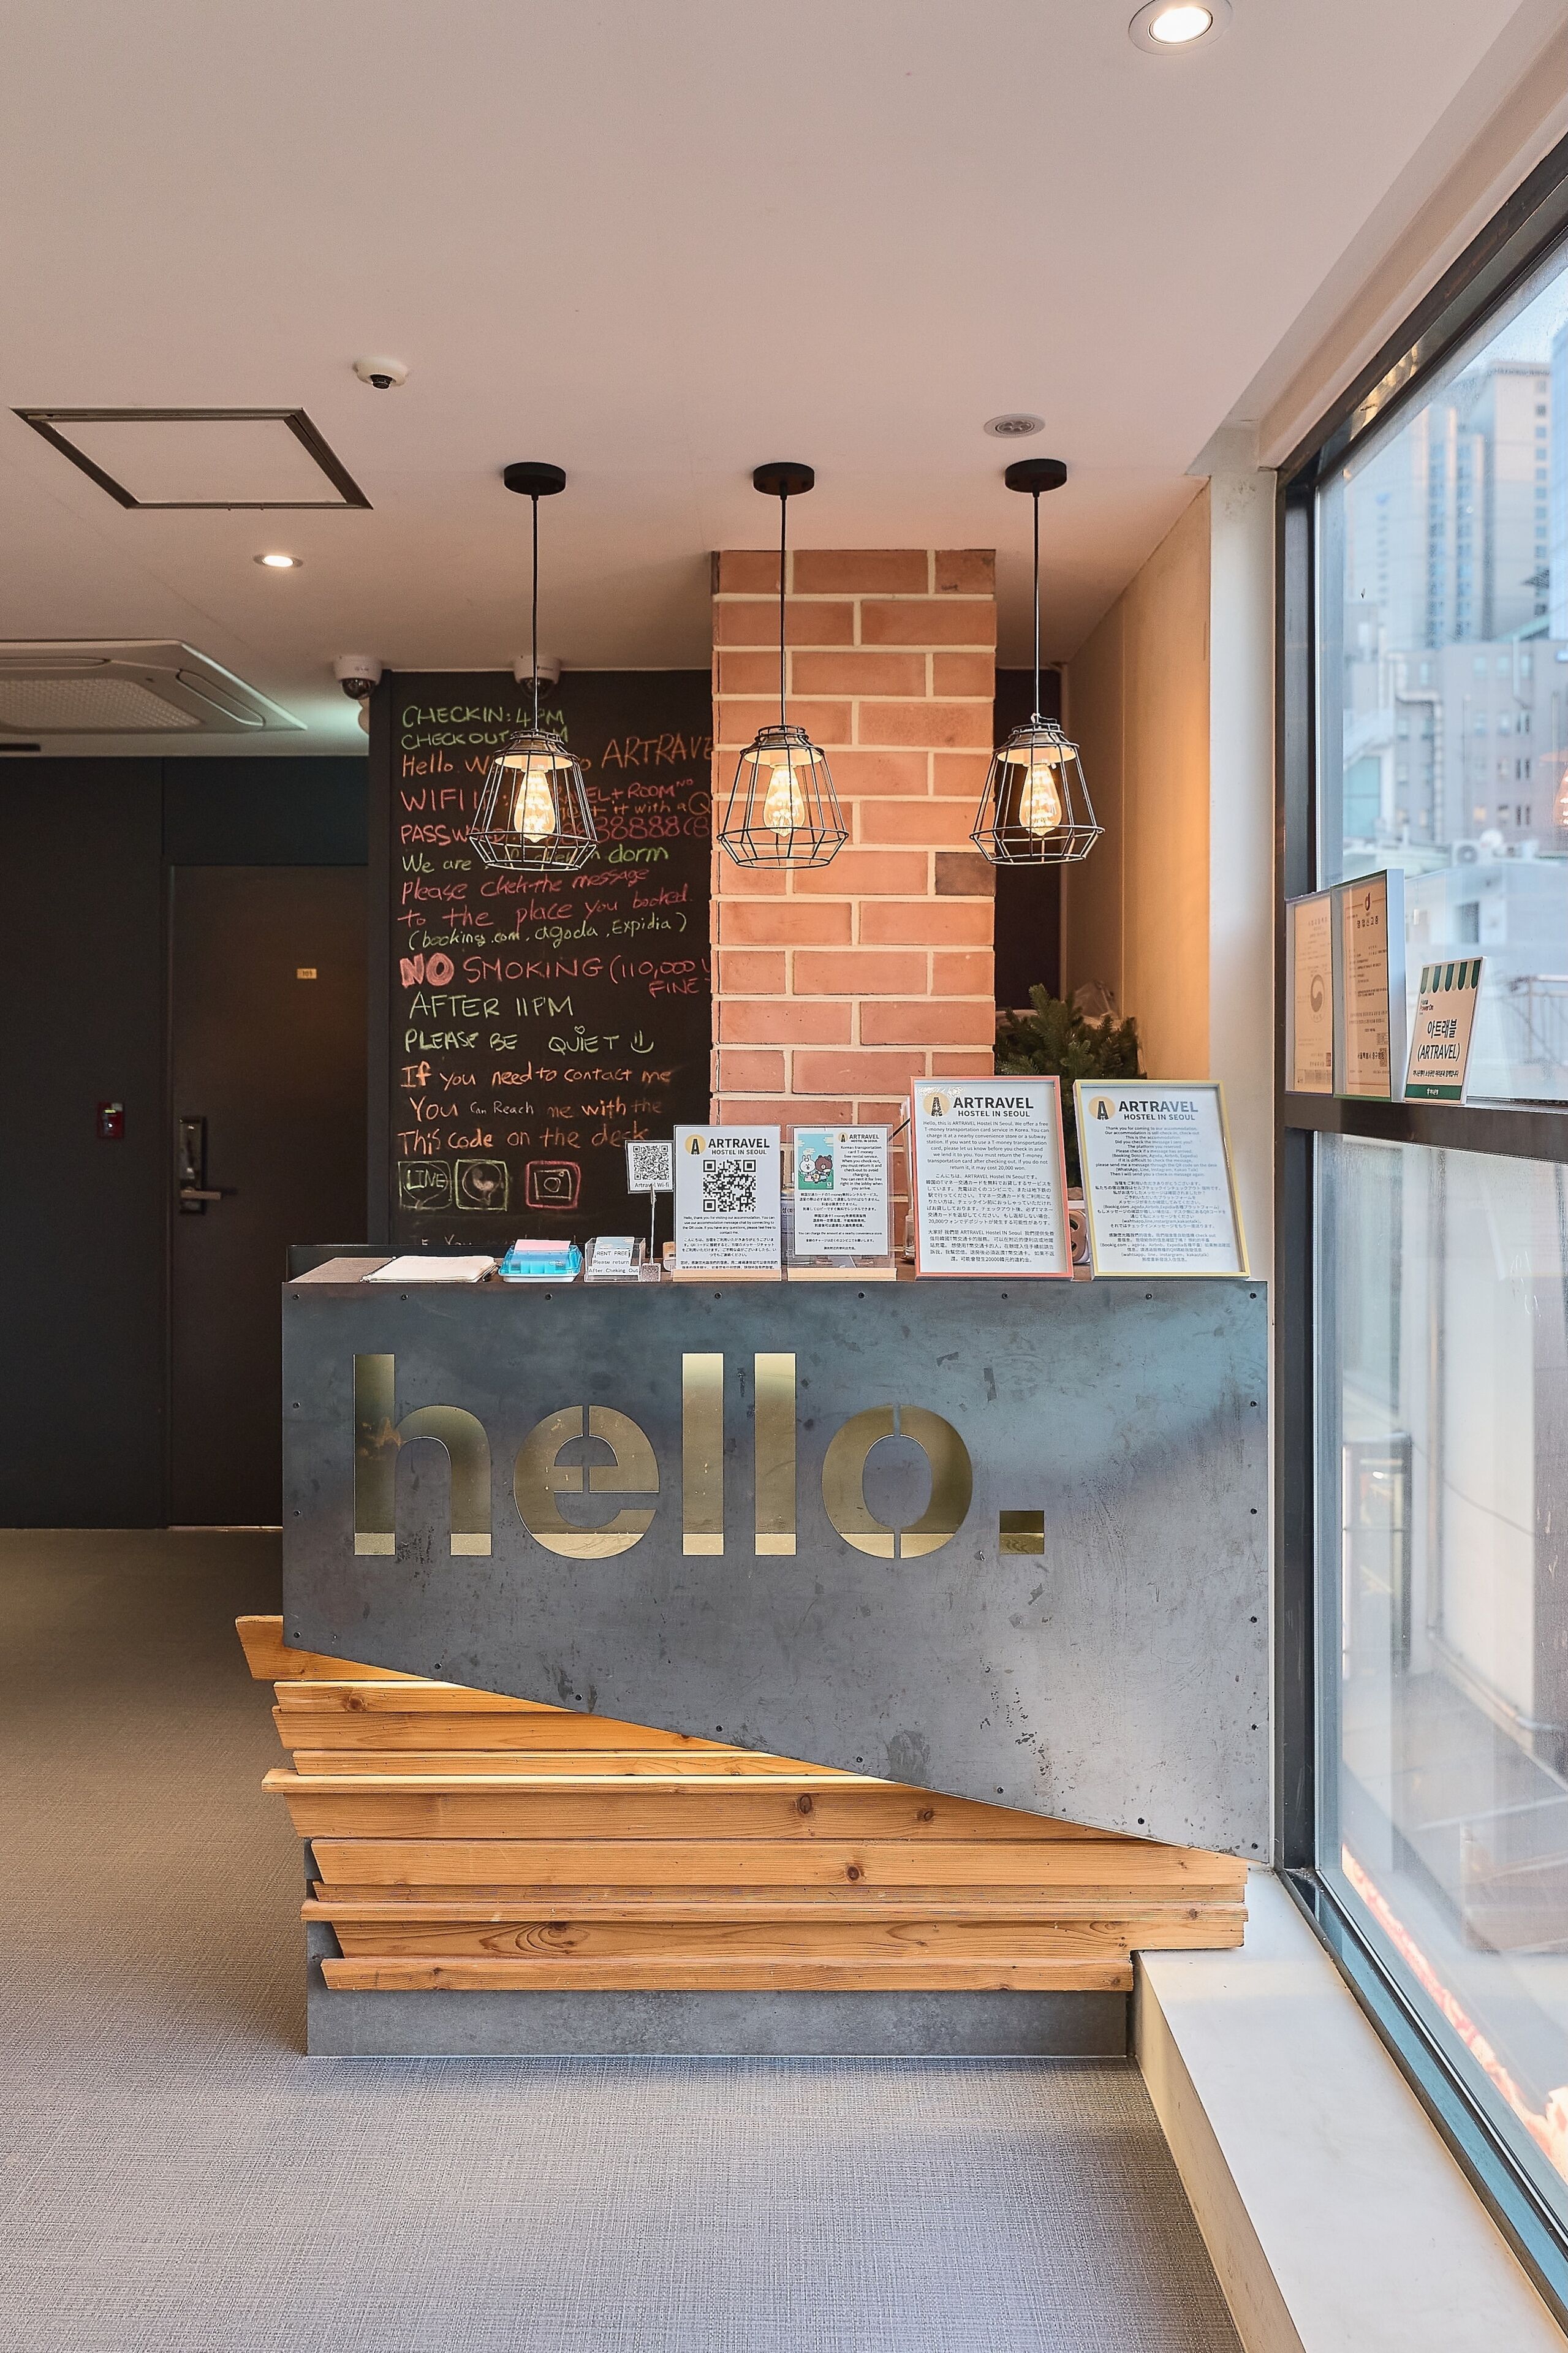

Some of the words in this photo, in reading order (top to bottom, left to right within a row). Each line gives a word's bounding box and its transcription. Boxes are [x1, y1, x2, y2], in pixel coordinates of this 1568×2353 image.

[400, 788, 464, 812] WIFI
[402, 853, 434, 873] We
[443, 860, 472, 871] are
[608, 843, 670, 864] dorm
[572, 869, 650, 889] message
[397, 909, 426, 927] to
[442, 904, 494, 927] the
[516, 898, 572, 933] place
[585, 900, 618, 919] you
[400, 952, 455, 988] NO
[463, 956, 604, 983] SMOKING
[409, 991, 500, 1019] AFTER
[405, 1028, 479, 1053] PLEASE
[490, 1033, 518, 1051] BE
[1428, 1019, 1457, 1039] 아트래블
[1418, 1043, 1460, 1062] (ARTRAVEL)
[401, 1060, 431, 1088] If
[439, 1072, 476, 1091] you
[492, 1061, 532, 1086] need
[536, 1067, 557, 1082] to
[641, 1070, 672, 1084] me
[409, 1095, 458, 1122] You
[493, 1101, 534, 1115] Reach
[547, 1105, 574, 1118] me
[581, 1095, 626, 1119] with
[953, 1097, 1034, 1109] ARTRAVEL
[1119, 1101, 1199, 1112] ARTRAVEL
[398, 1128, 441, 1156] This
[507, 1131, 531, 1147] on
[539, 1127, 581, 1148] the
[708, 1139, 770, 1148] ARTRAVEL
[407, 1168, 445, 1191] LINE
